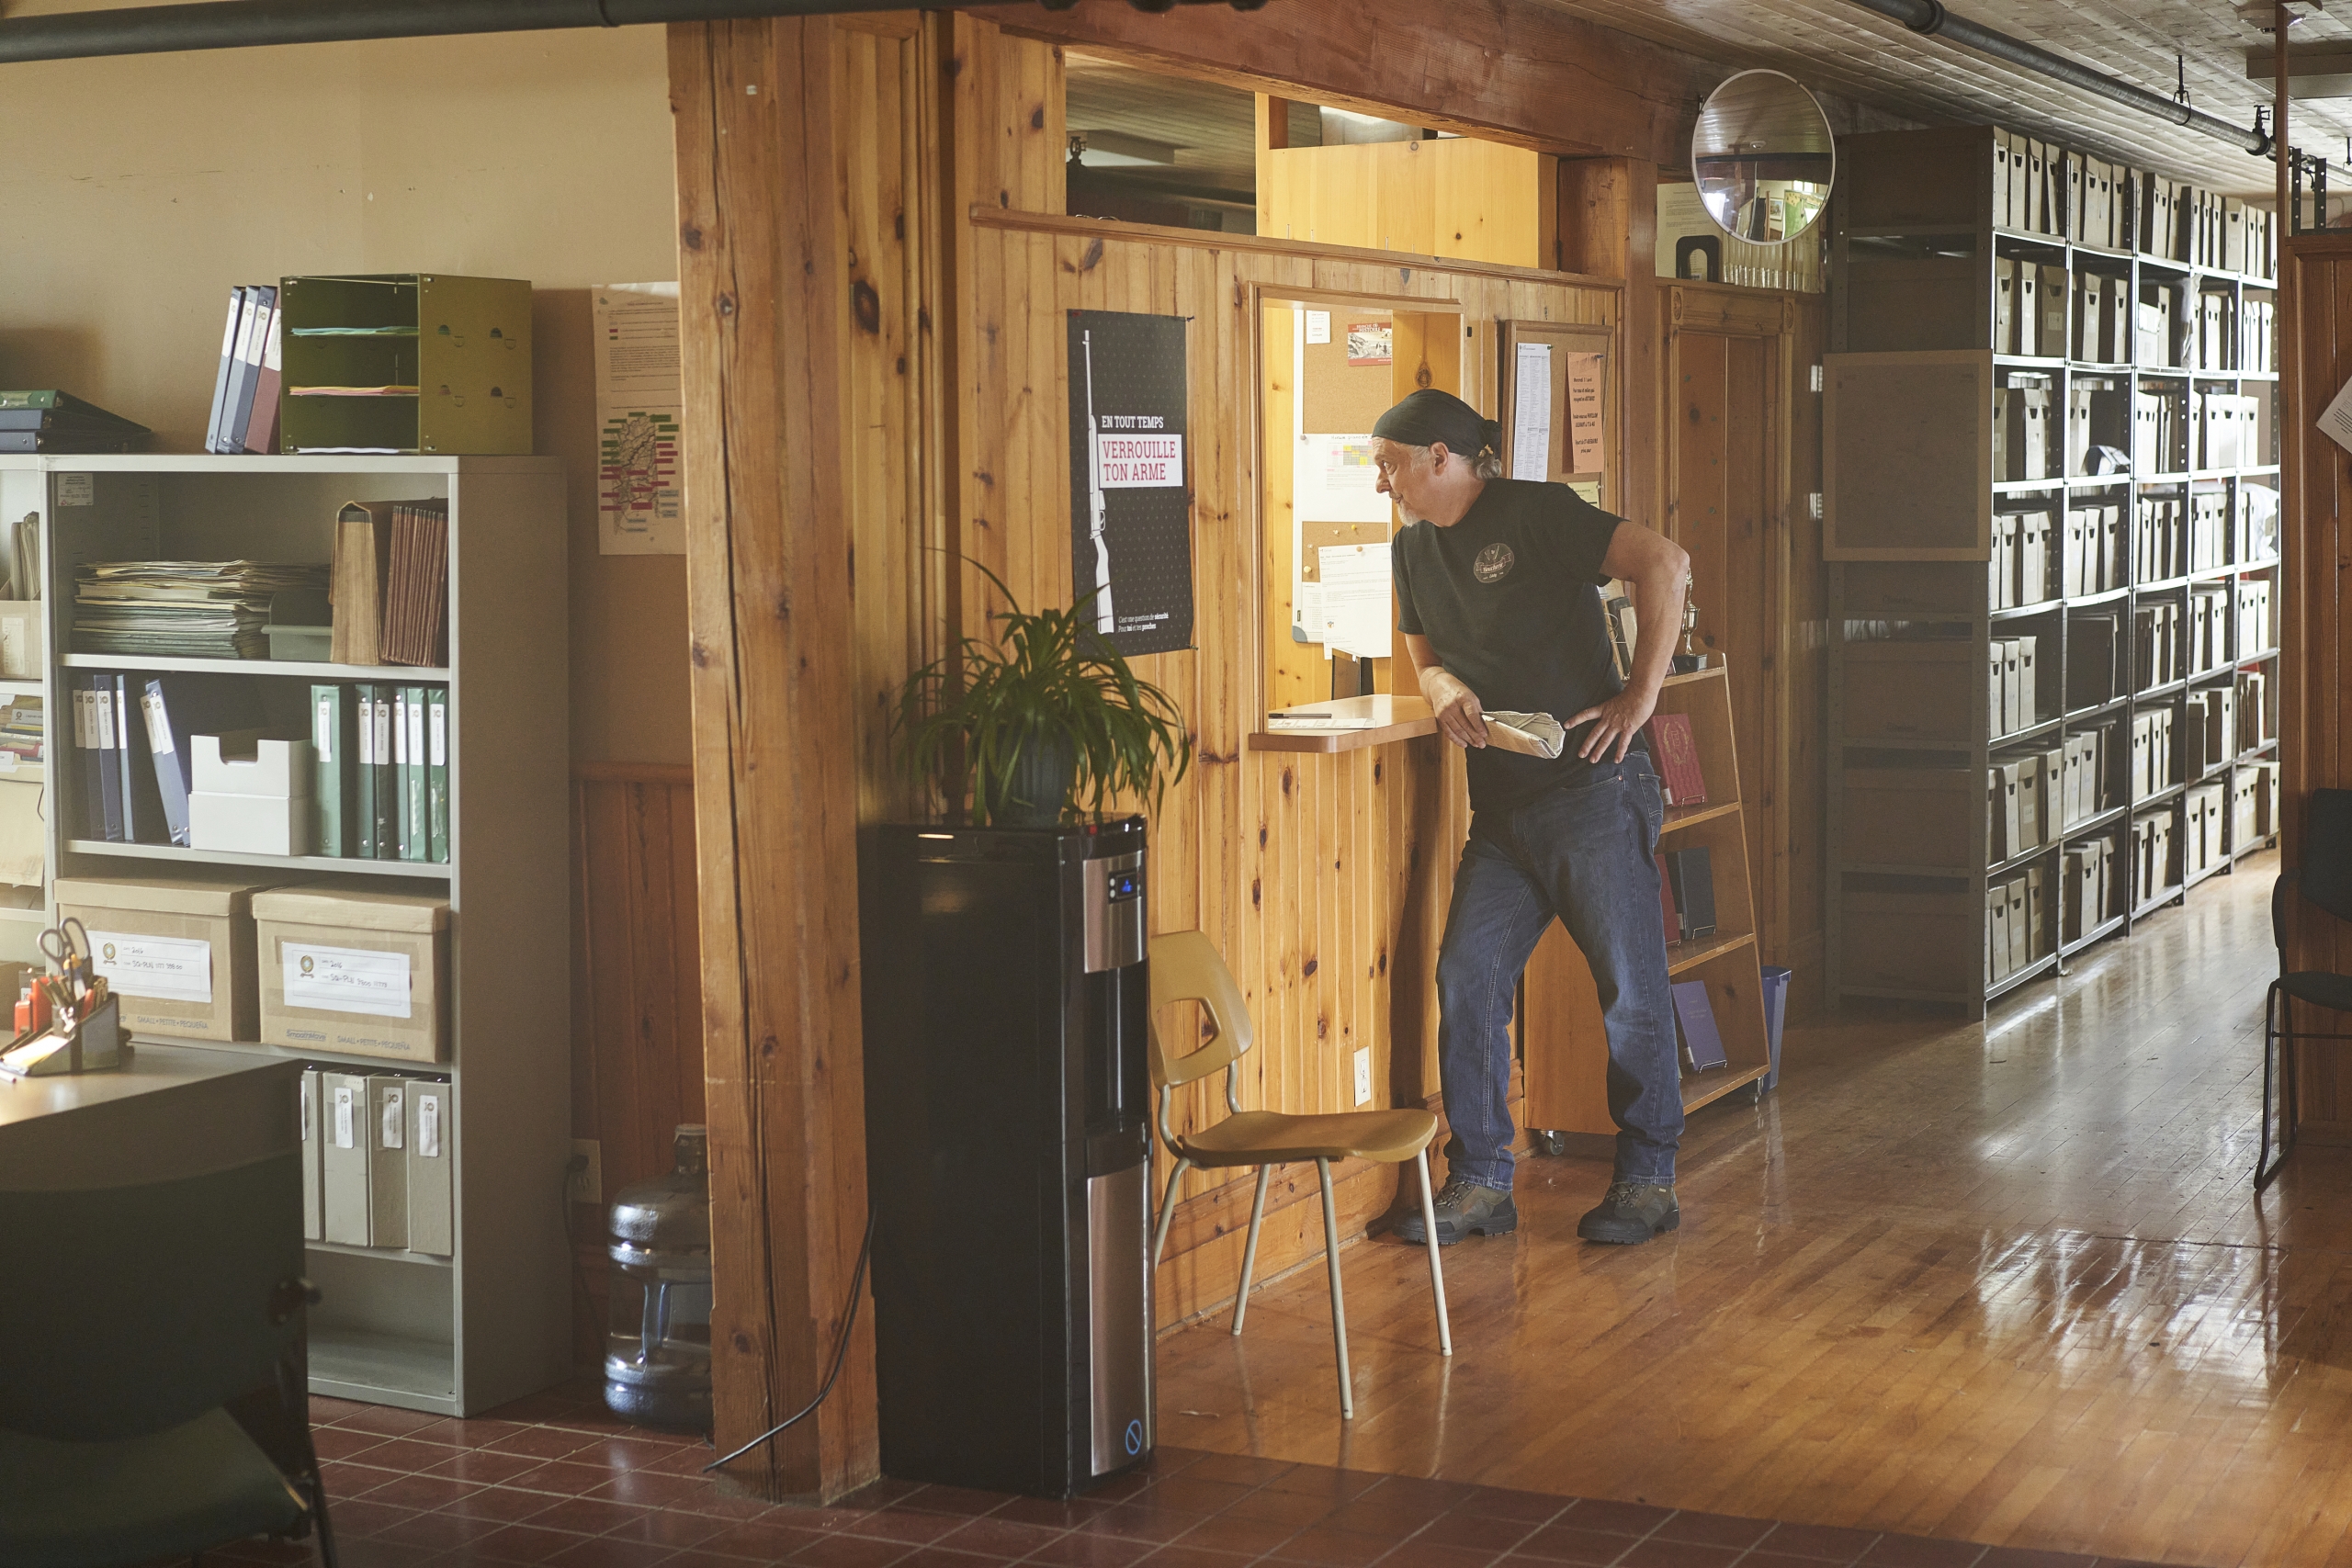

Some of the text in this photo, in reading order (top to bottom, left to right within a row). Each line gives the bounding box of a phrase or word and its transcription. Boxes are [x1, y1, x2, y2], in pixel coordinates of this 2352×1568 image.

[1102, 415, 1164, 429] EN TOUT TEMPS
[1102, 441, 1176, 459] VERROUILLE
[1103, 463, 1166, 481] TON ARME
